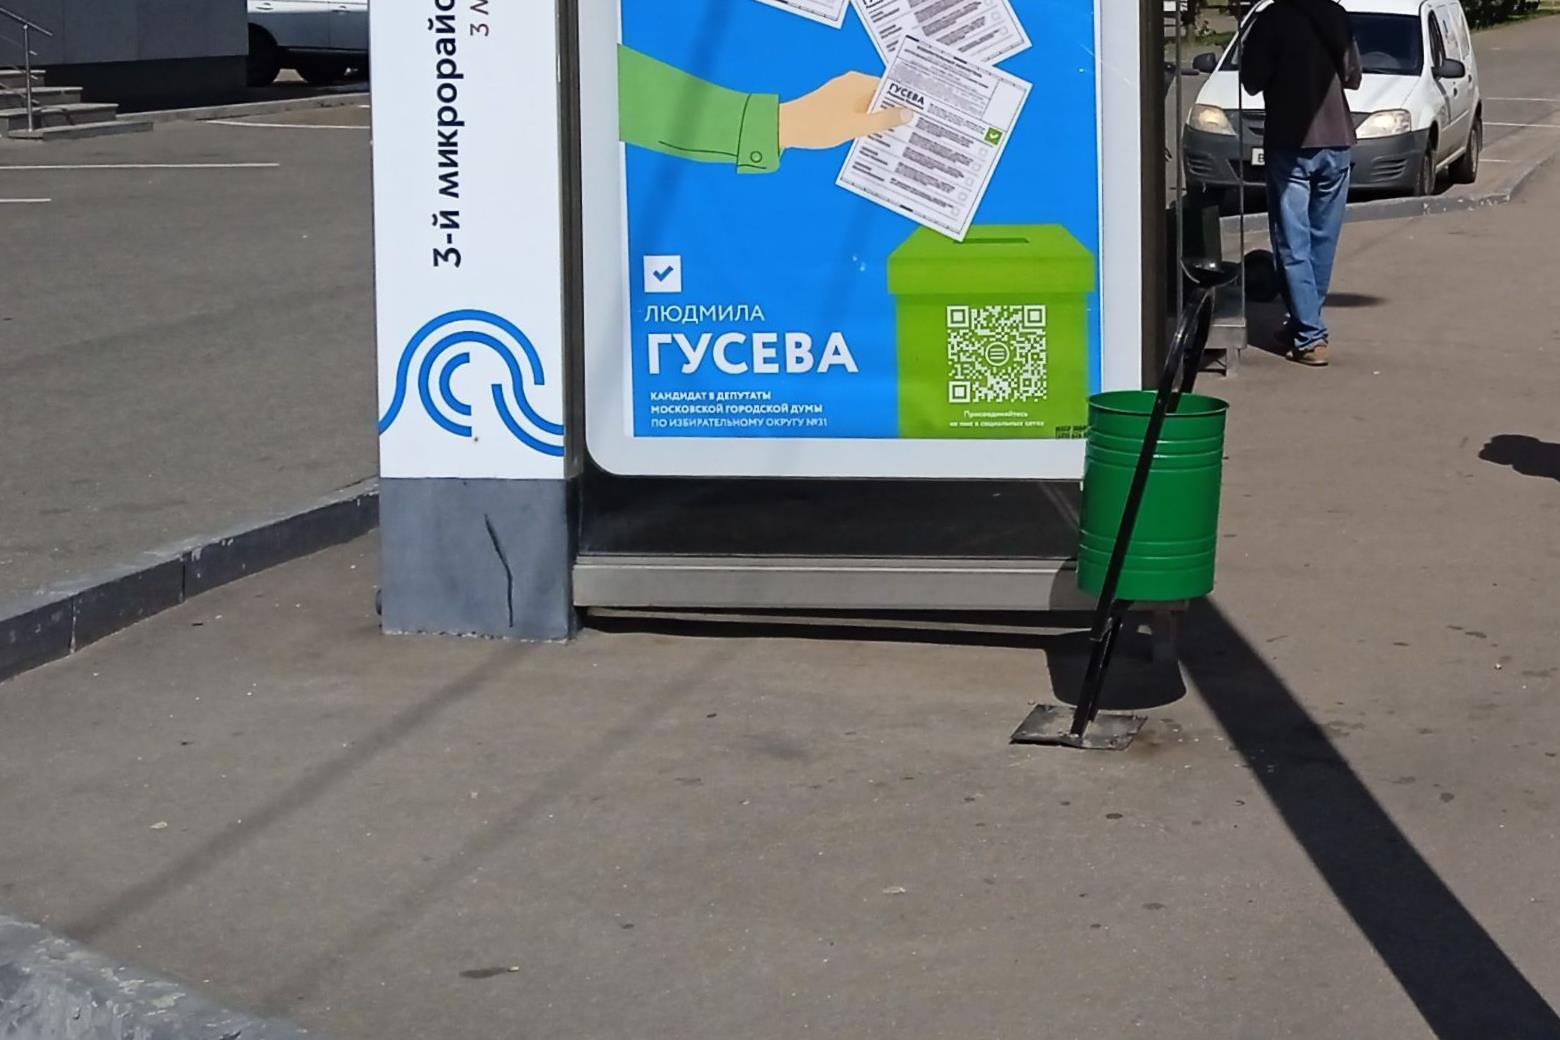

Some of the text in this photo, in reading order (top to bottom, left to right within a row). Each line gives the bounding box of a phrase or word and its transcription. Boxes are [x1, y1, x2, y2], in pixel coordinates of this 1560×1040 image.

[470, 22, 489, 37] 3
[888, 82, 926, 106] ГУСЕВА
[432, 210, 462, 268] 3-й
[643, 304, 766, 325] ЛЮДМИЛА
[647, 332, 859, 376] ГУСЕВА
[650, 391, 771, 401] КАНДИДАТ В ДЕПУТАТЫ
[650, 403, 823, 415] МОСКОВСКОЙ ГОРОДСКОЙ ДУМЫ
[651, 417, 828, 428] ПО ИЗБИРАТЕЛЬНОМУ ОКРУГУ №31
